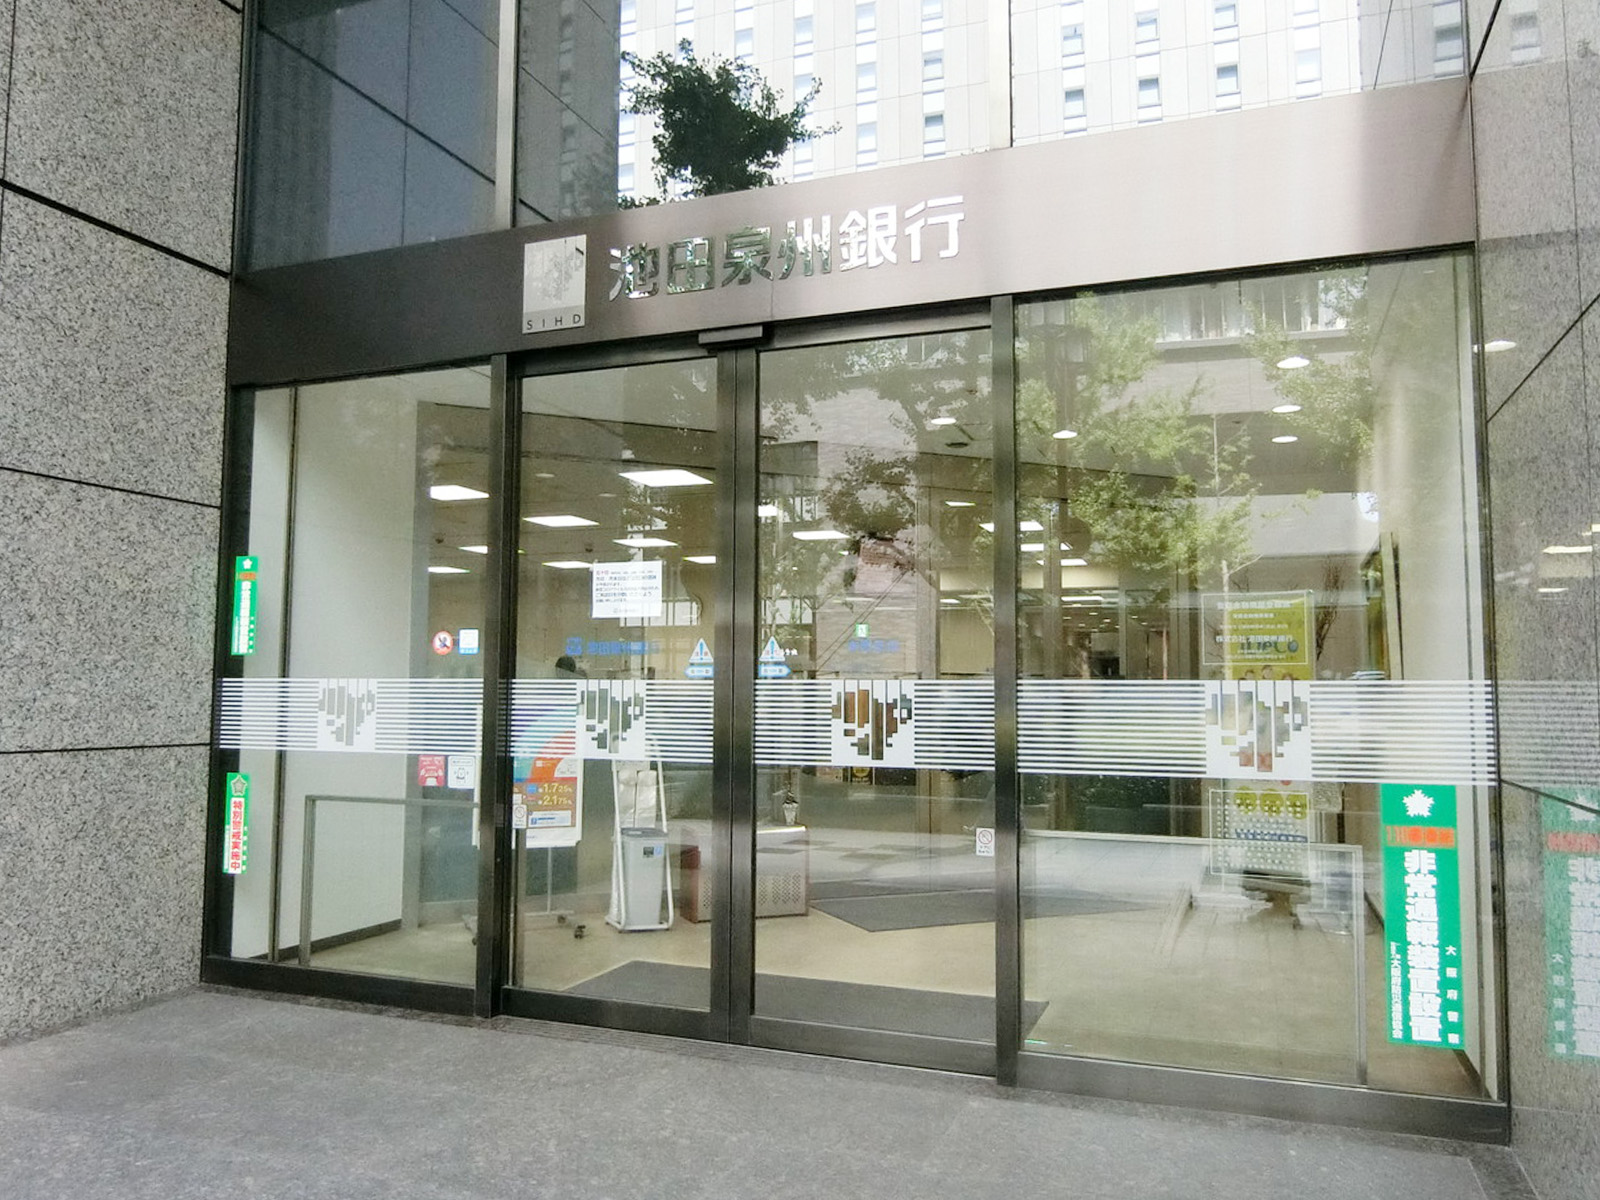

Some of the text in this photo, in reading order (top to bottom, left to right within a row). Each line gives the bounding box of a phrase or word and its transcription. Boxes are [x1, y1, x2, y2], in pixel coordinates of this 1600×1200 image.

[608, 195, 965, 301] 池田泉州銀行
[527, 314, 581, 330] SIHD
